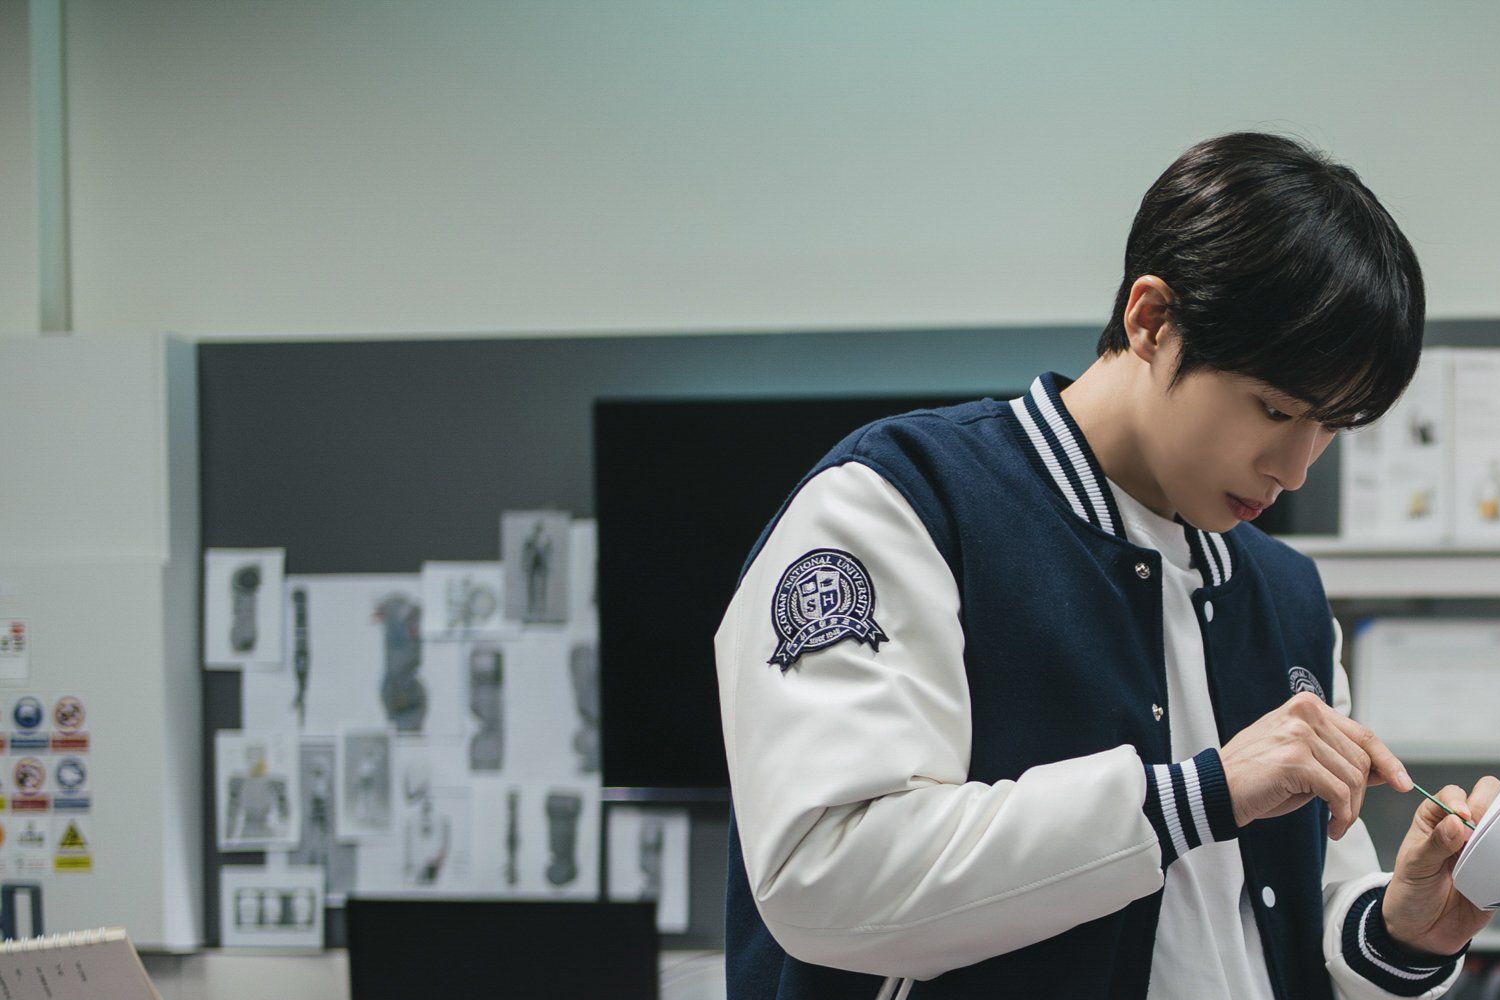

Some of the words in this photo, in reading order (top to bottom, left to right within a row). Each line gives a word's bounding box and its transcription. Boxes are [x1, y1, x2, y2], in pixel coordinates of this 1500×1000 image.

[786, 555, 832, 589] NATIONAL
[837, 558, 868, 617] UNIVERSITY
[823, 594, 834, 606] H
